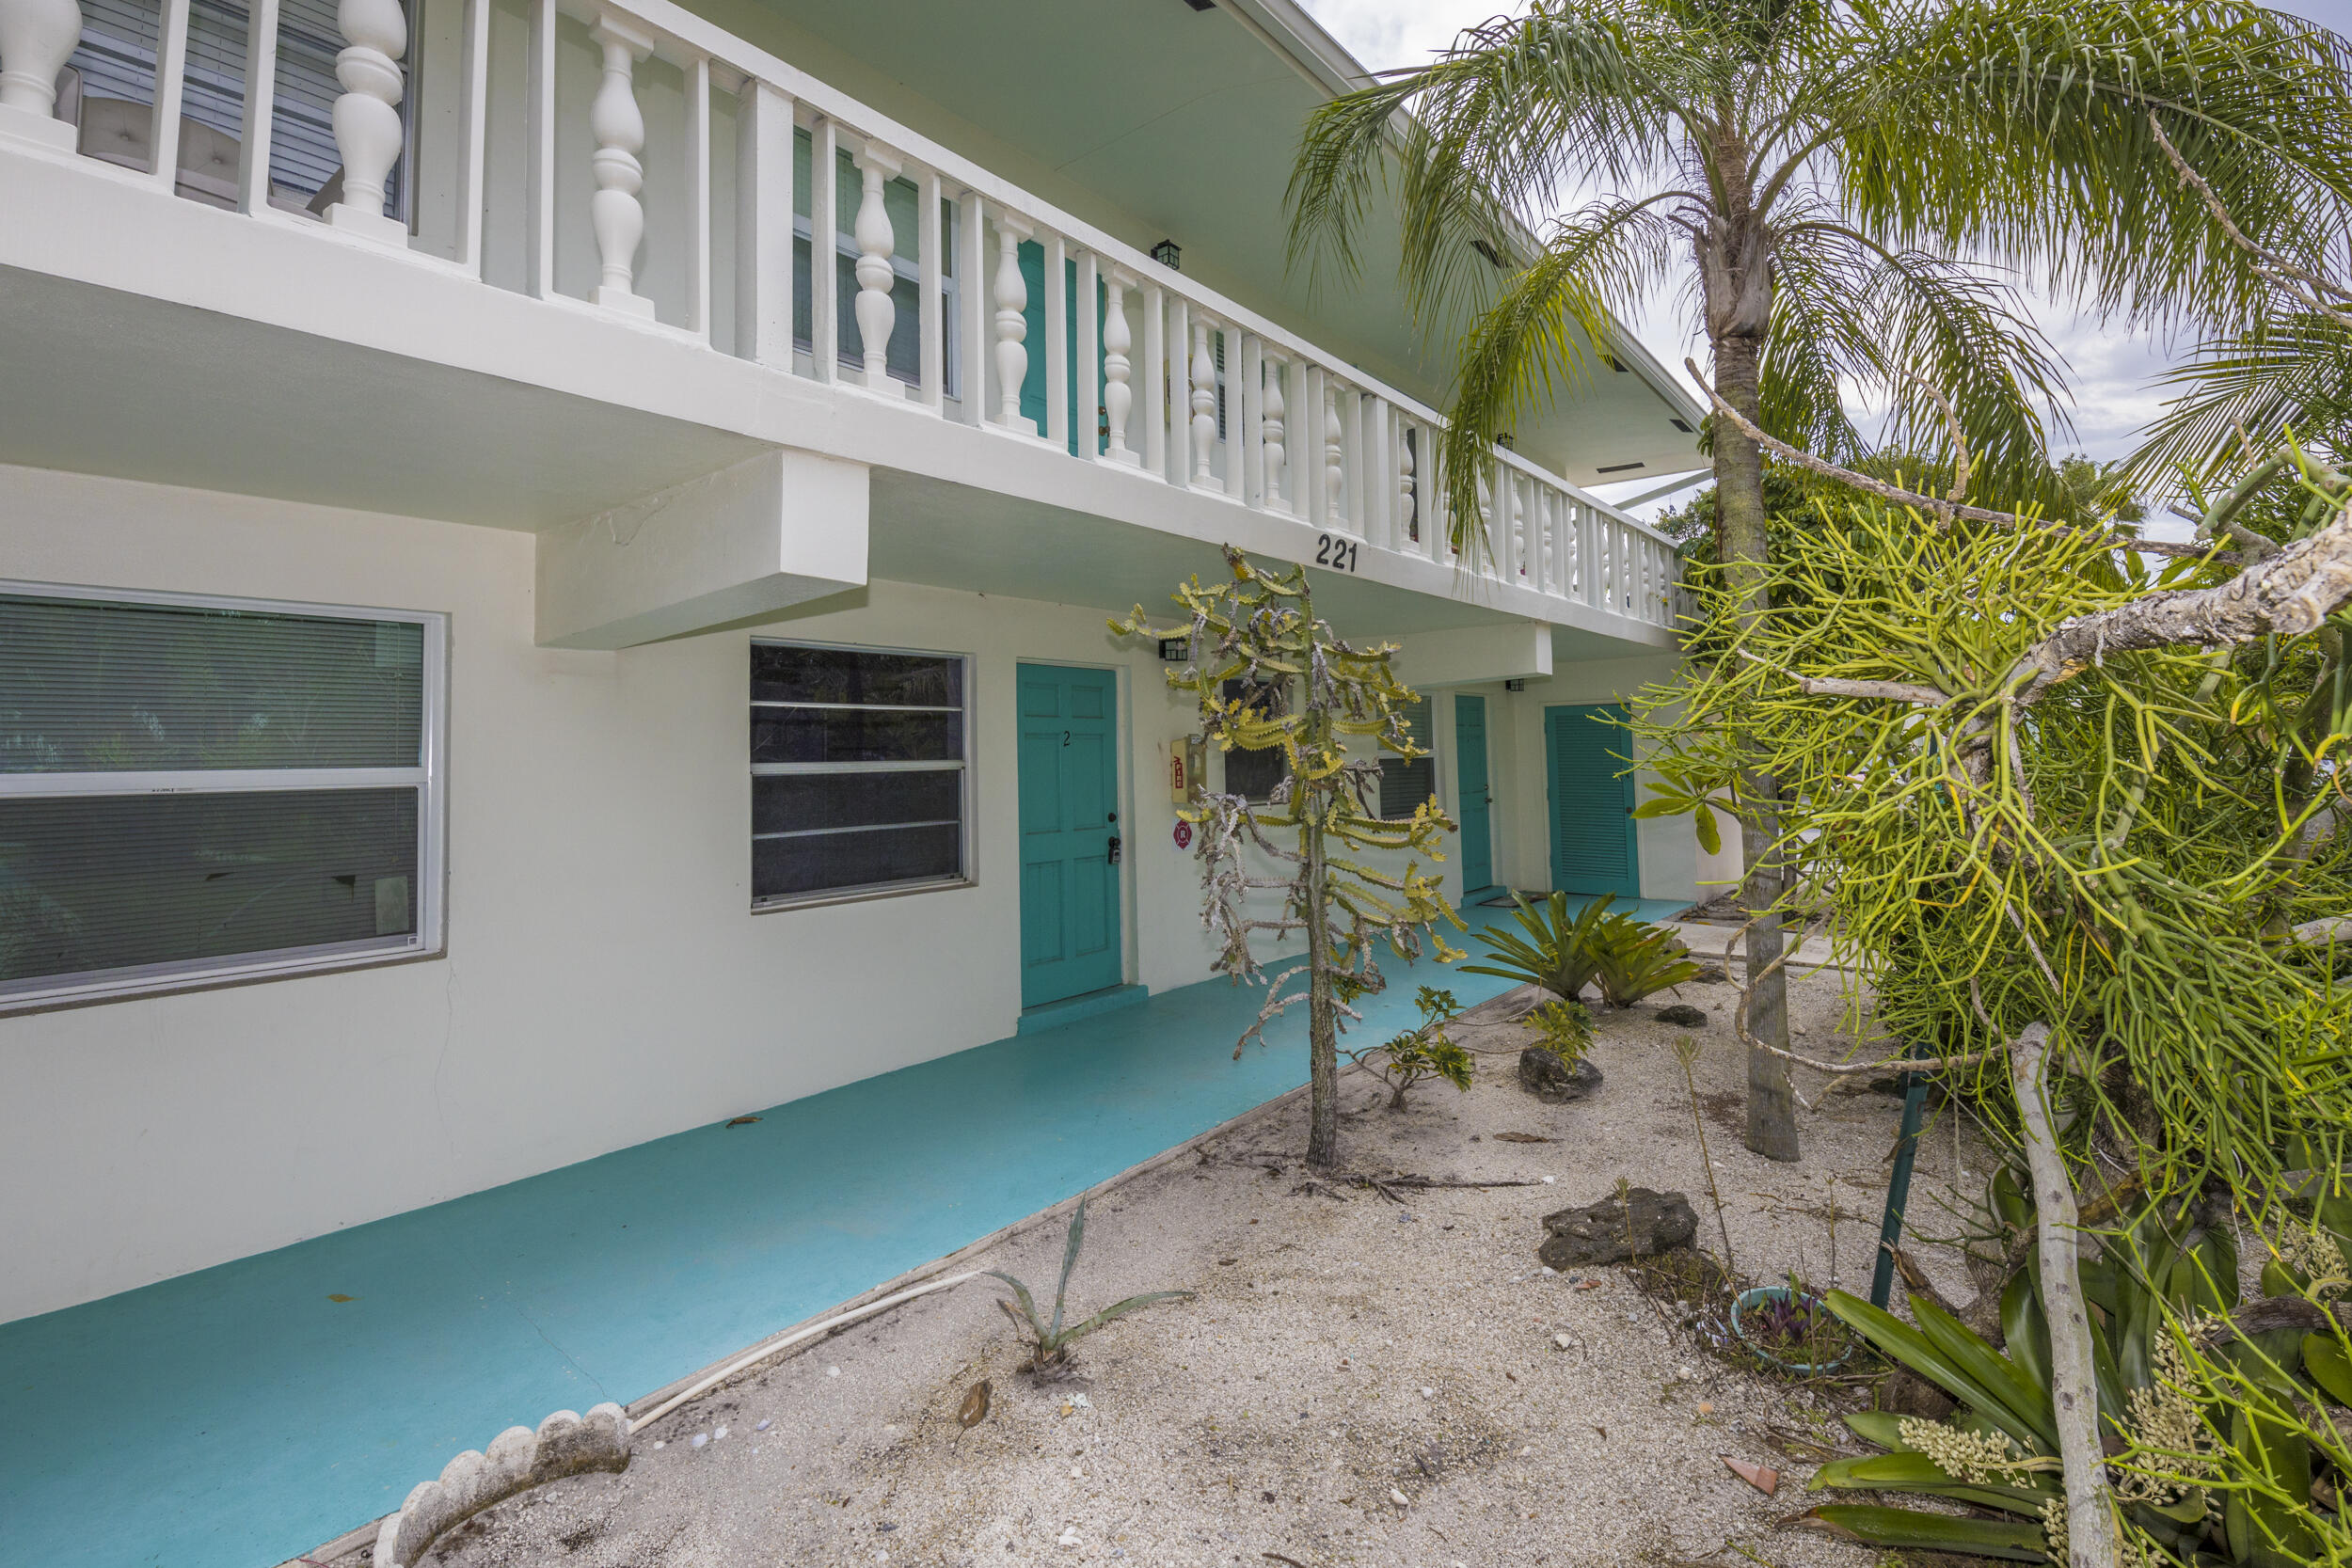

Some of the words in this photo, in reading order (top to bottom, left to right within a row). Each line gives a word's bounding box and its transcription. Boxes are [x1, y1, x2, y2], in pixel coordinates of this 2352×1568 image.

[1316, 534, 1357, 572] 221
[1063, 730, 1070, 747] 2
[1180, 830, 1185, 839] R
